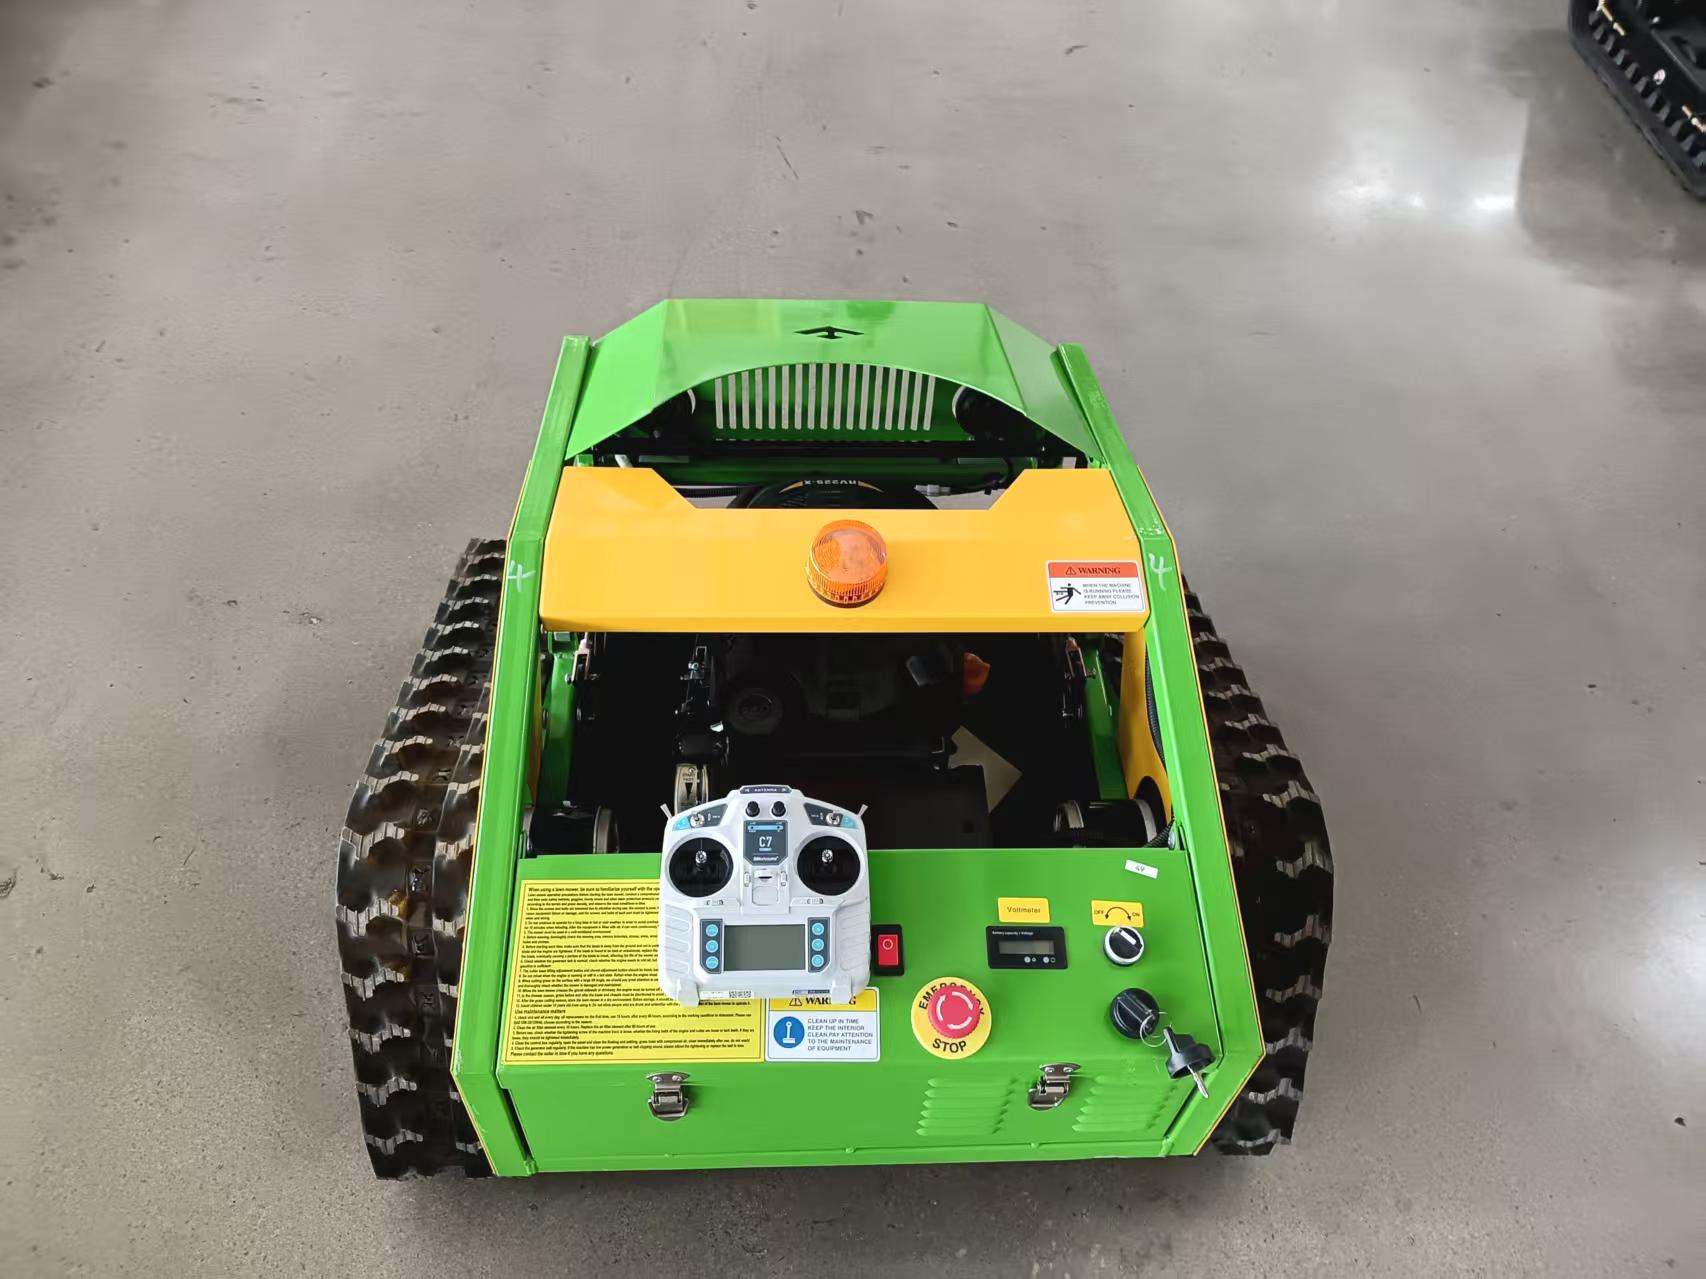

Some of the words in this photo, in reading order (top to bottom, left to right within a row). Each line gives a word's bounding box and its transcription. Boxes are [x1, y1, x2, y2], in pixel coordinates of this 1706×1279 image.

[508, 559, 537, 593] 4
[1148, 552, 1173, 592] 4
[759, 836, 773, 848] C7
[932, 1038, 966, 1053] STOP
